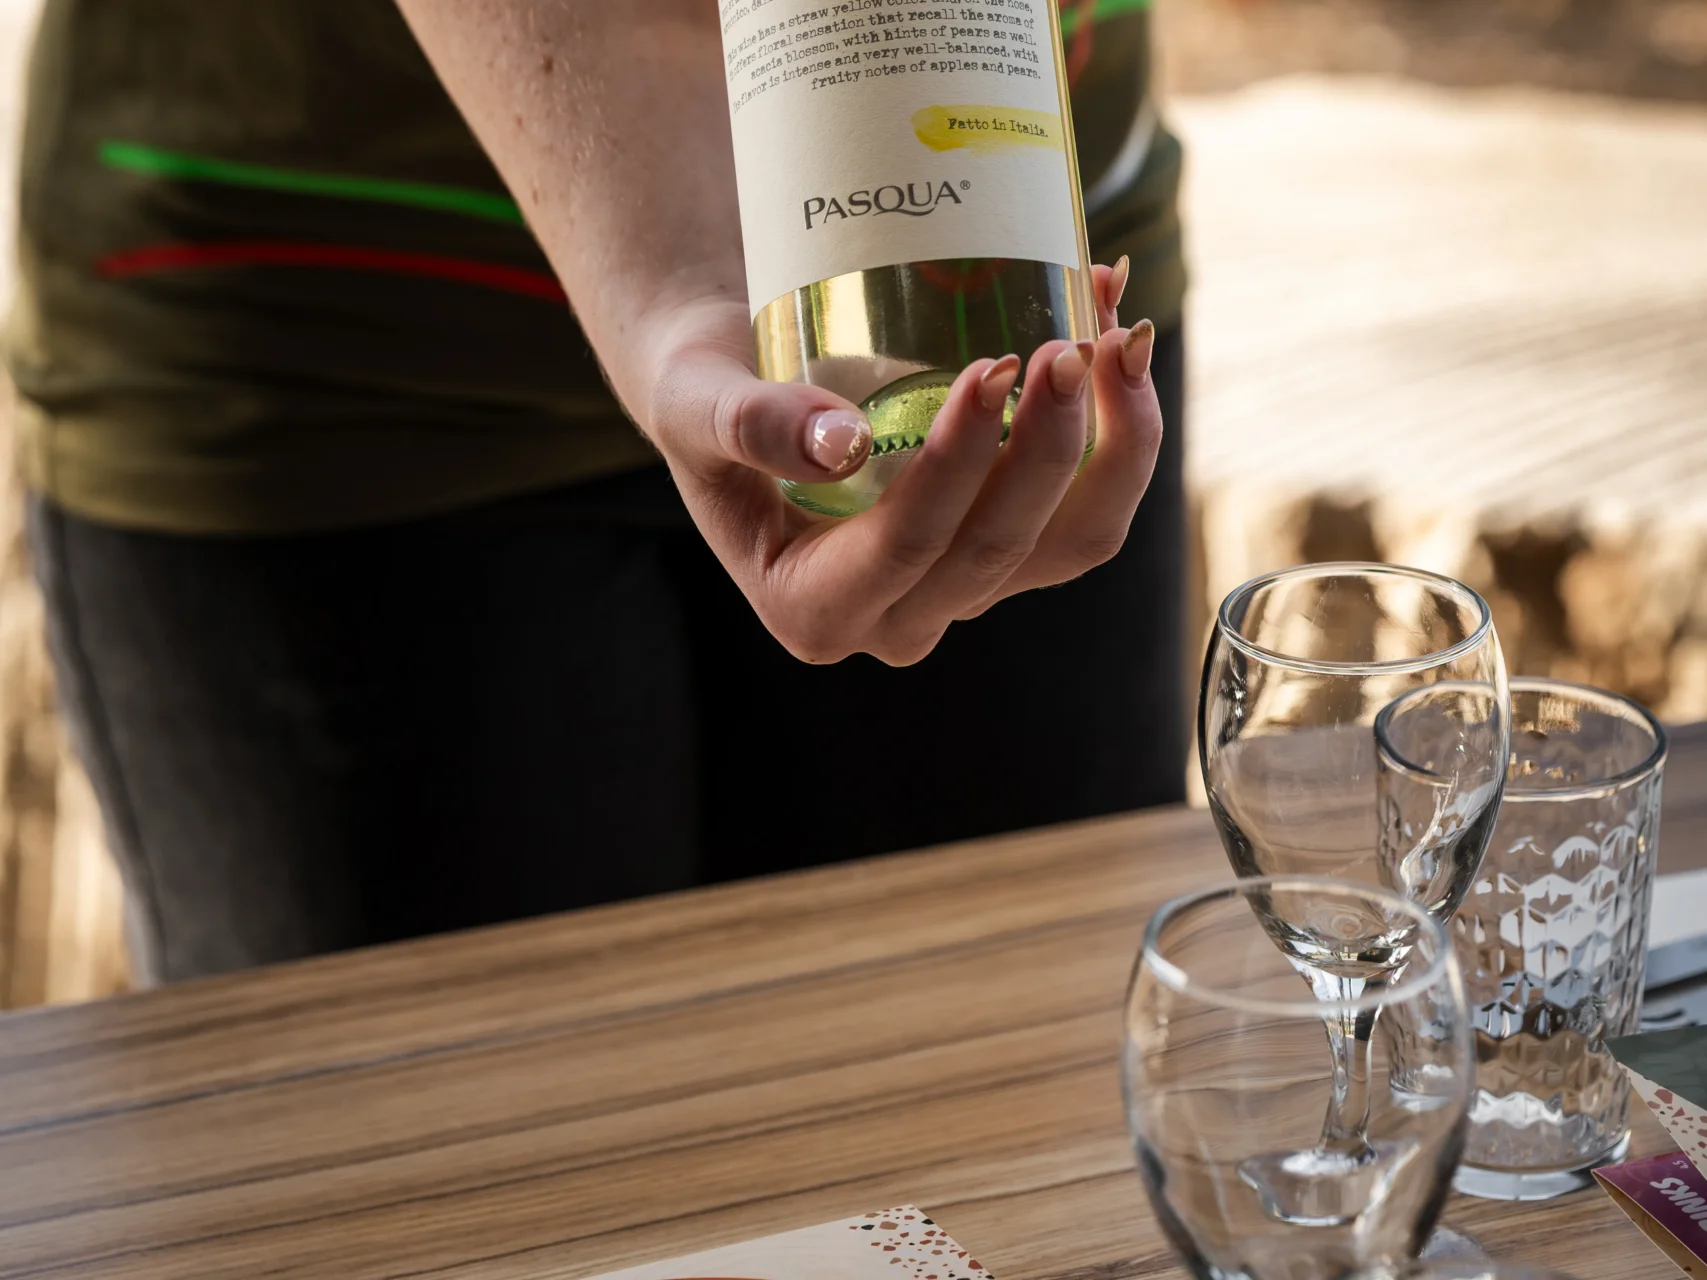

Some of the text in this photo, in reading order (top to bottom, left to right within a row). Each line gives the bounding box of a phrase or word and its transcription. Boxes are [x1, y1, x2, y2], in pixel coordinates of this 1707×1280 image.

[738, 34, 757, 53] wine
[757, 24, 777, 41] has
[778, 21, 786, 31] a
[788, 7, 828, 28] straw
[832, 0, 882, 17] yellow
[757, 35, 793, 58] floral
[795, 18, 865, 43] sensation
[868, 11, 904, 26] that
[908, 8, 957, 21] recall
[960, 8, 984, 21] the
[987, 12, 1022, 26] aroma
[1023, 18, 1035, 29] of
[740, 81, 767, 106] flavor
[769, 75, 780, 88] is
[782, 59, 832, 82] intense
[834, 51, 861, 66] and
[863, 47, 899, 60] very
[903, 41, 1011, 58] well-balanced,
[1012, 48, 1039, 64] with
[750, 56, 783, 80] acacia
[785, 41, 839, 64] blossom,
[842, 30, 880, 47] with
[883, 27, 927, 41] hints
[930, 25, 947, 37] of
[950, 26, 990, 39] pears
[993, 31, 1007, 39] as
[1009, 32, 1037, 46] well.
[811, 59, 1041, 91] fruity notes of apples and pears.
[947, 117, 1049, 138] Fatto in Italia.
